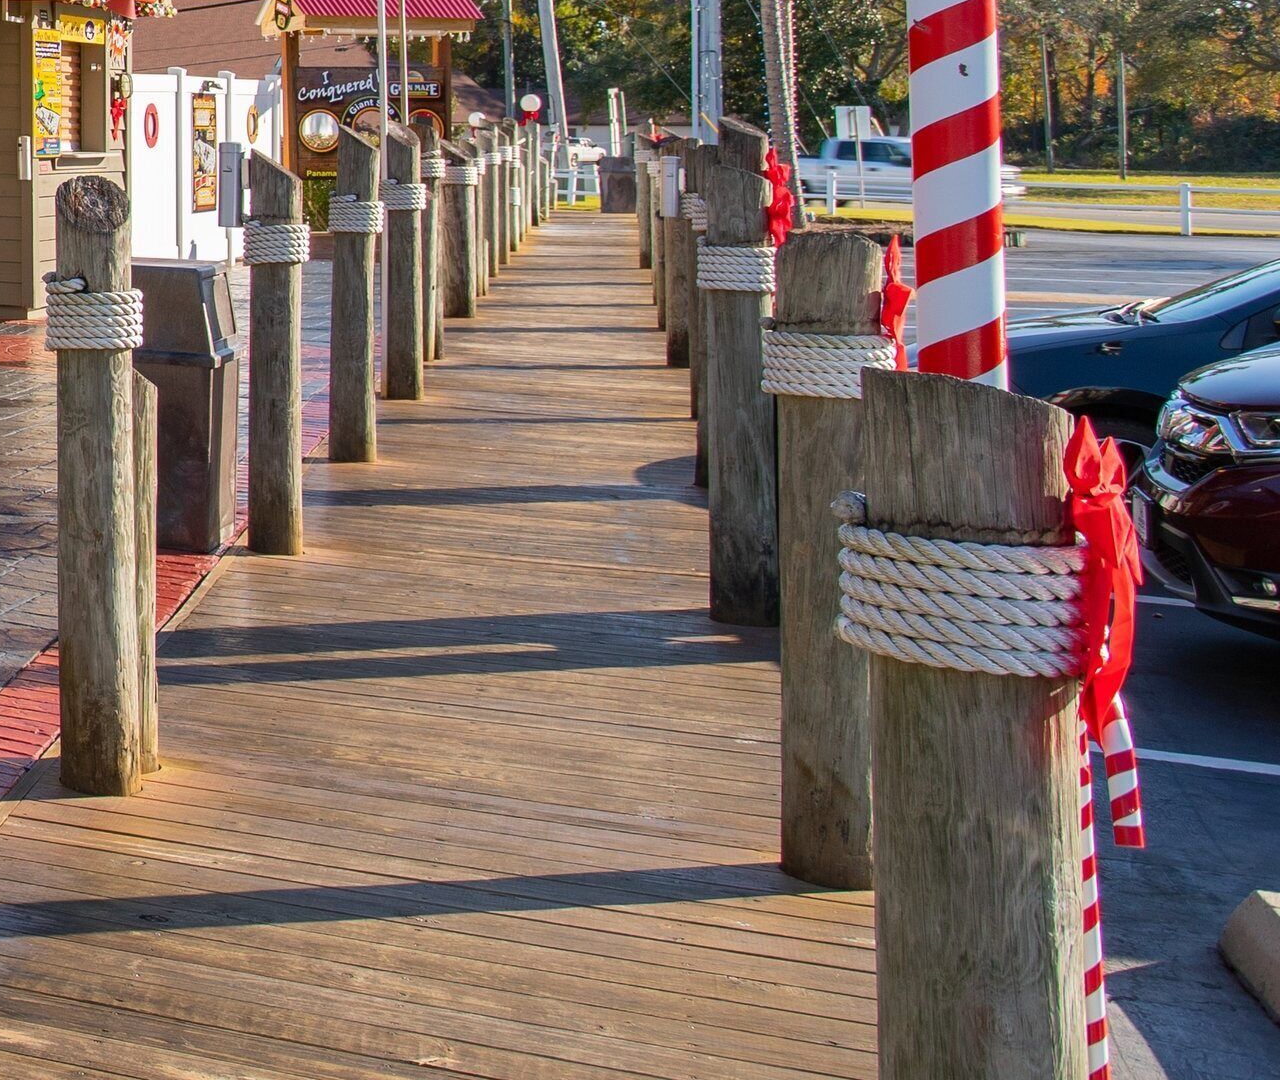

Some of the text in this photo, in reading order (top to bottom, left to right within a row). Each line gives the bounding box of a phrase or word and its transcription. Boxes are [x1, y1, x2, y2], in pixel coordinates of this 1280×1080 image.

[321, 70, 329, 85] I
[297, 73, 377, 103] Conquered
[390, 83, 438, 95] GN MAZE
[349, 98, 374, 115] Giant
[306, 169, 337, 178] Panama
